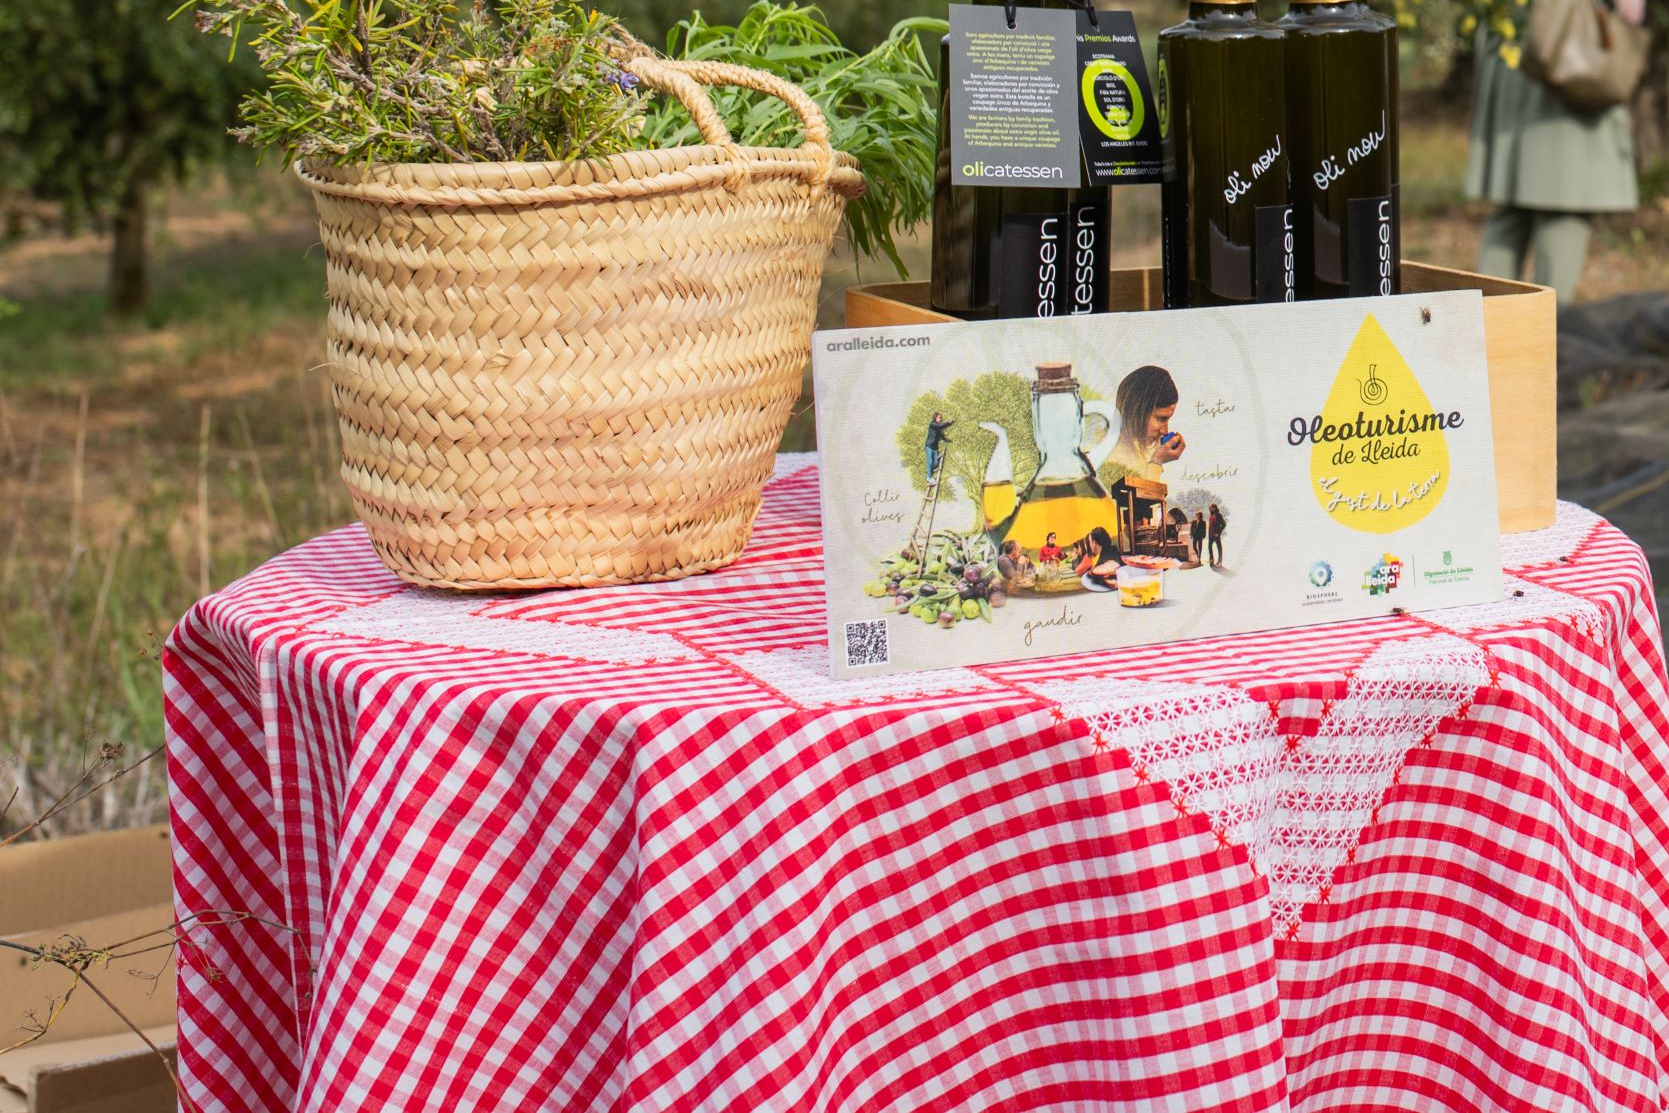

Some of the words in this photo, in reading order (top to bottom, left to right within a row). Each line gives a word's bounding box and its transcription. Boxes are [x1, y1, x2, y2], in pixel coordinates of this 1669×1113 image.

[1084, 34, 1112, 43] Premios
[1112, 34, 1136, 43] Awards
[962, 161, 1063, 179] olicatessen
[1313, 154, 1346, 190] oli
[1223, 170, 1252, 204] oli
[826, 335, 931, 352] aralleida.com
[1194, 398, 1236, 418] tastar
[1287, 409, 1465, 447] Oleoturisme
[1331, 443, 1357, 466] de
[1361, 437, 1421, 465] Lleida
[1180, 463, 1239, 483] descobrir
[1370, 491, 1392, 511] de
[861, 509, 905, 524] olives
[1365, 573, 1396, 585] lleida
[1379, 564, 1399, 574] ara
[1306, 591, 1338, 600] BIOSPHERE
[1024, 604, 1083, 647] gaudir
